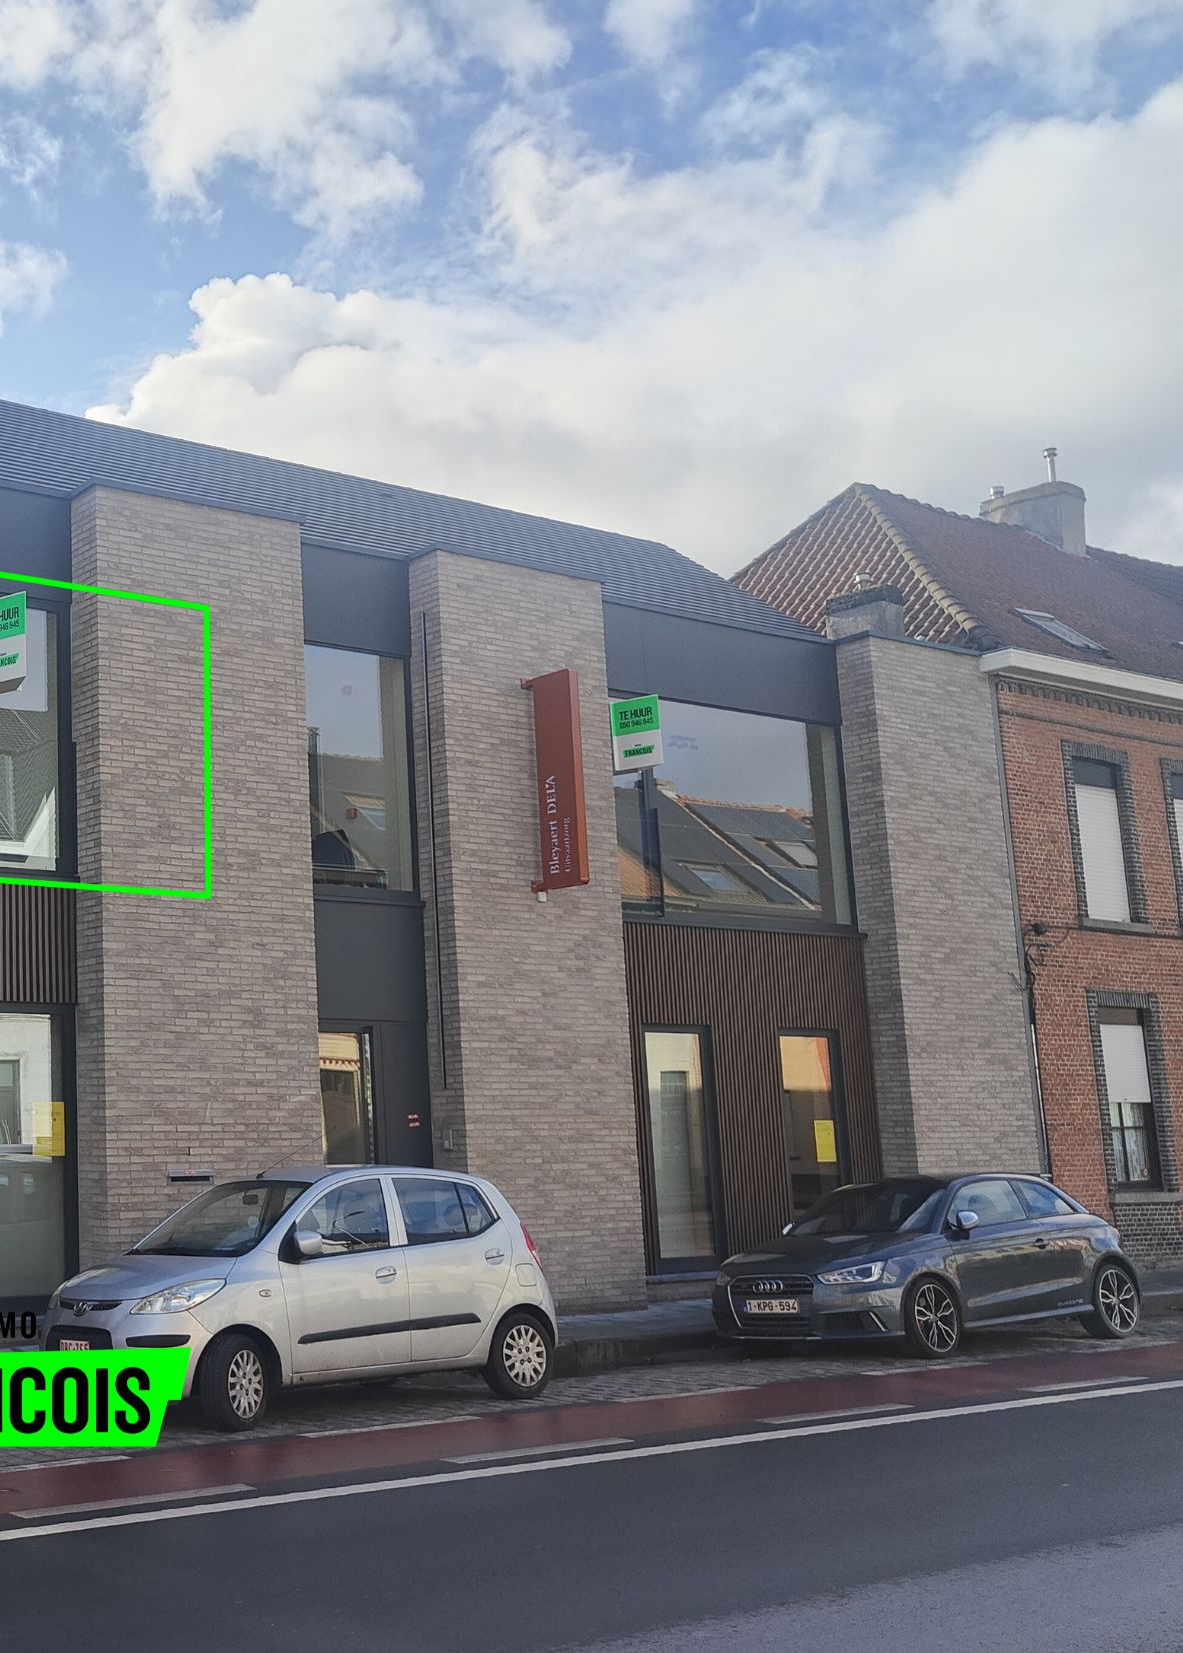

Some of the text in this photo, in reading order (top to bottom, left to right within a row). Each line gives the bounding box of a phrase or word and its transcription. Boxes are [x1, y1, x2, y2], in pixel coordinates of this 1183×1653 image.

[618, 706, 653, 720] TE HUUR
[549, 820, 561, 875] Bleyaert
